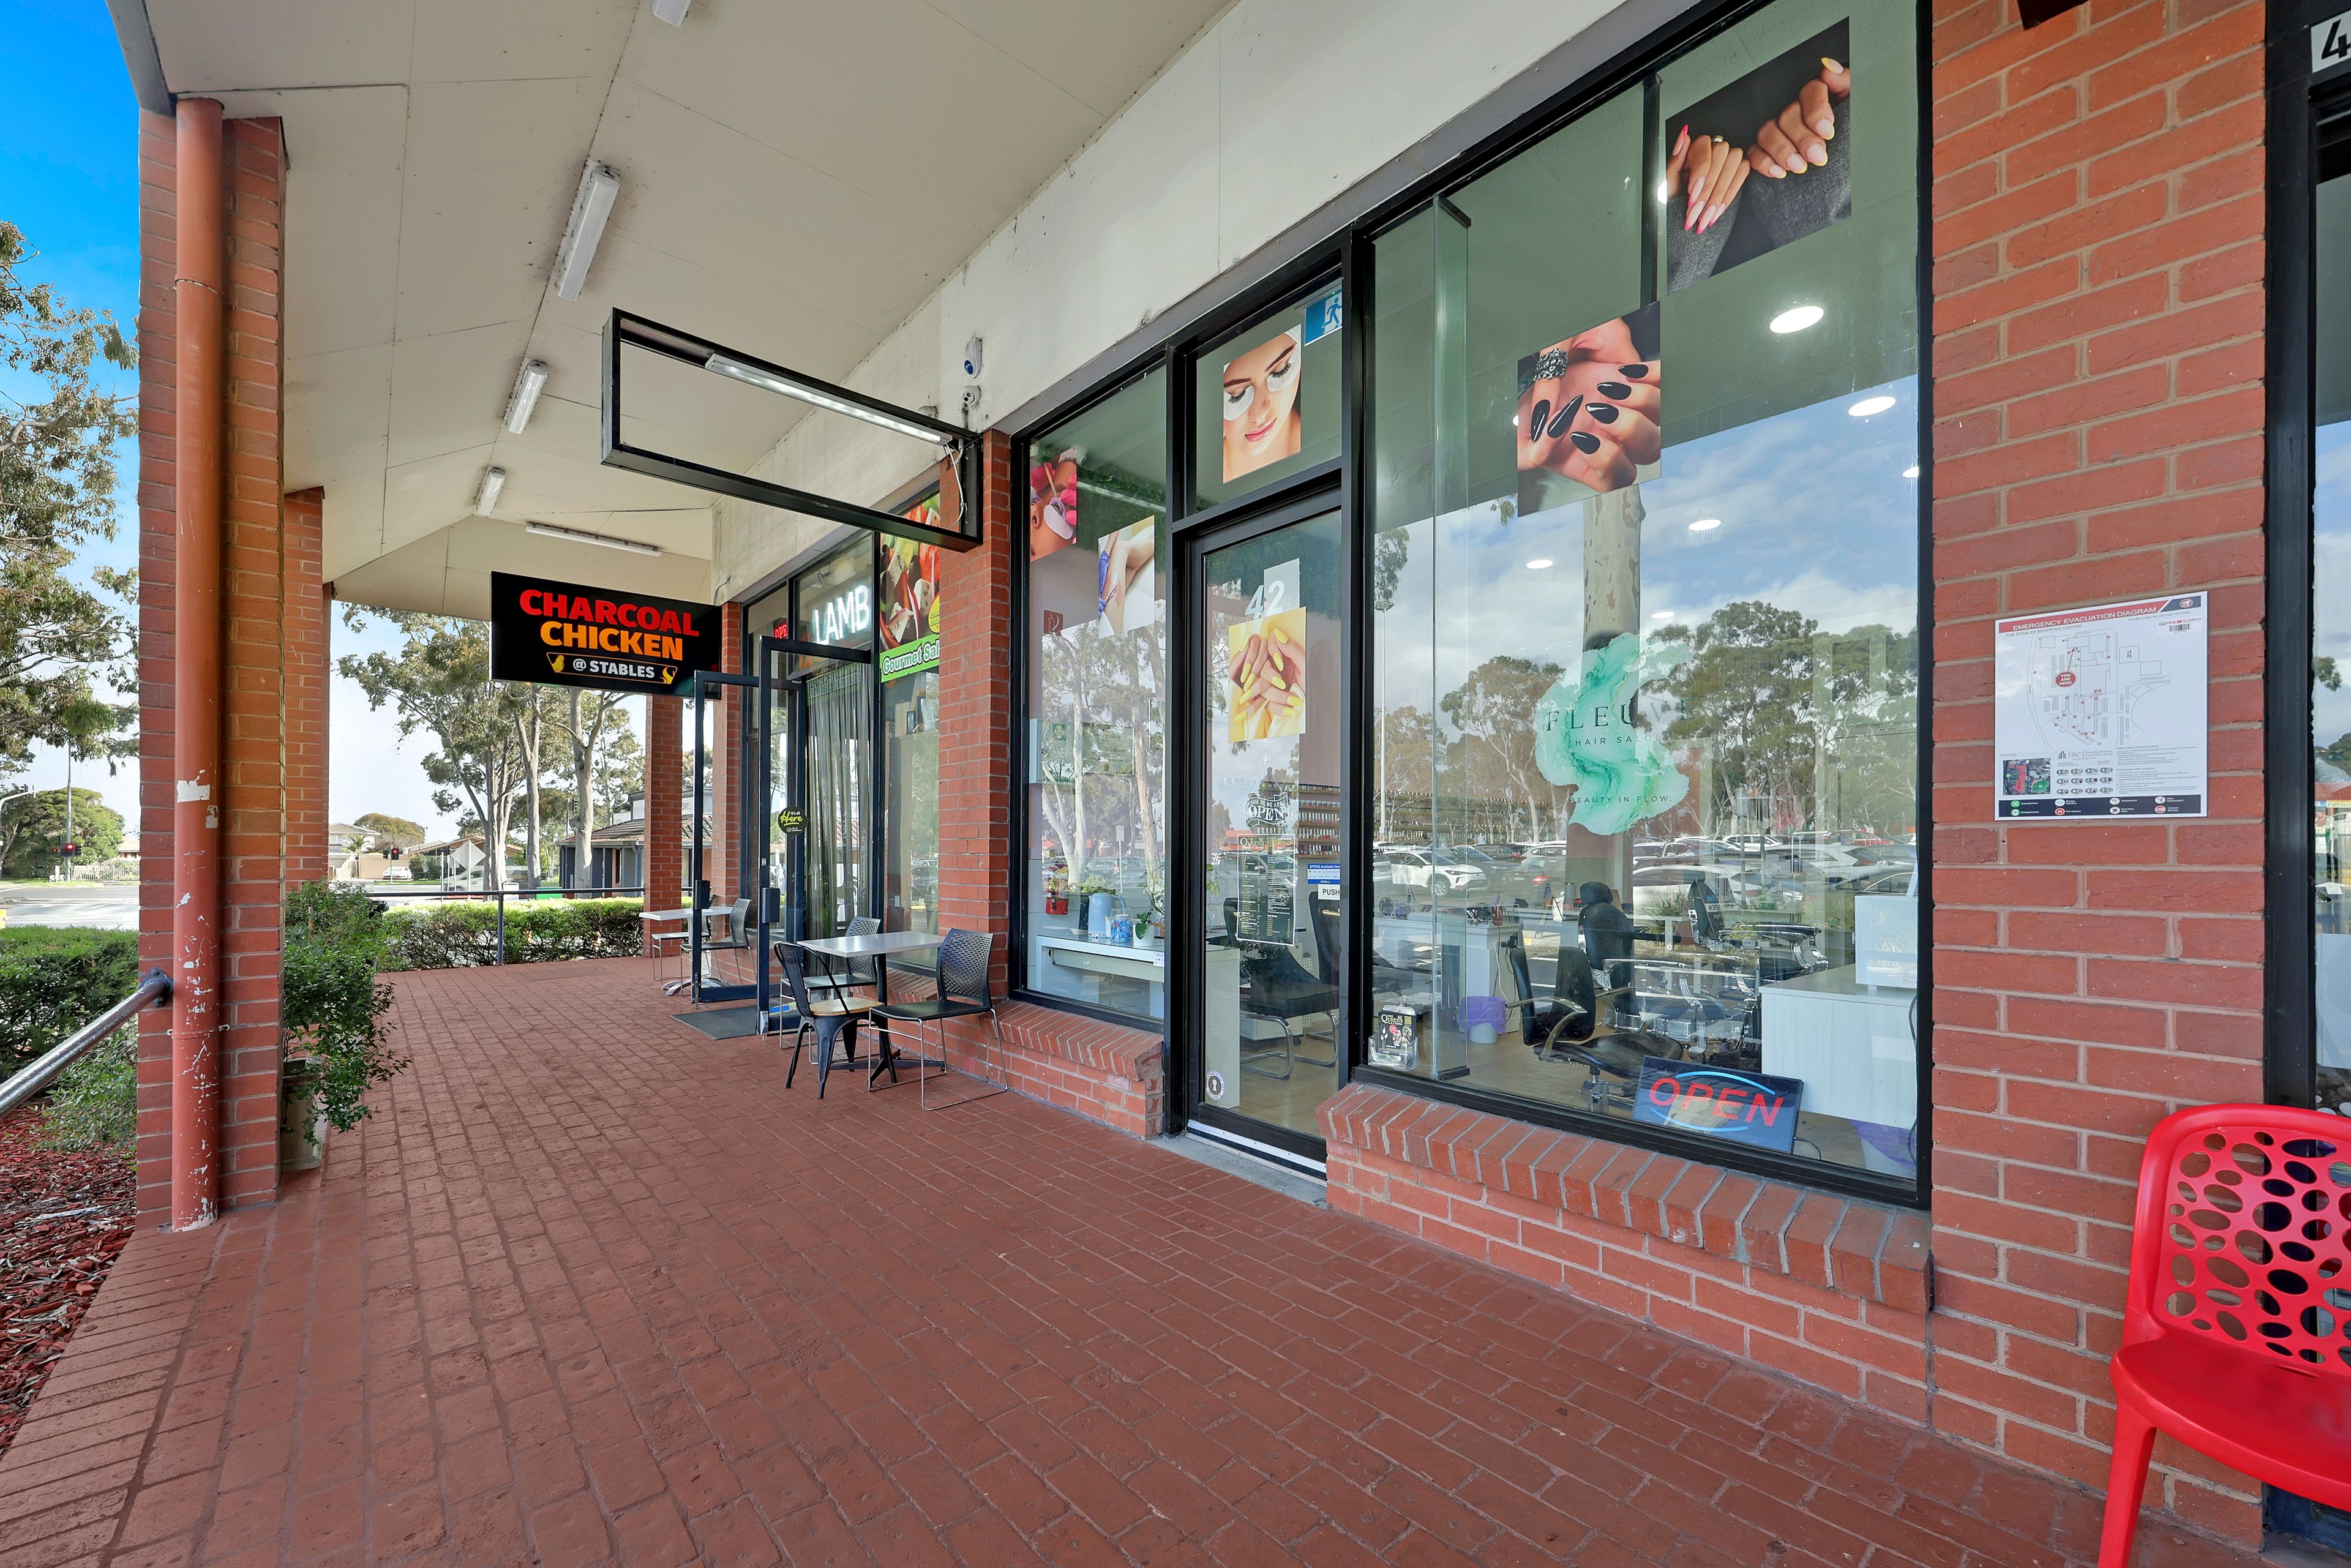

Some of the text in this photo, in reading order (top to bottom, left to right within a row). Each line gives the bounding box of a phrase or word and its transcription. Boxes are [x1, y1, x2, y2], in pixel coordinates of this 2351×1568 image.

[519, 589, 699, 636] CHARCOAL
[1245, 580, 1284, 619] 42
[814, 585, 869, 645] LAMB
[2013, 620, 2061, 631] EMERGENCY
[2064, 611, 2116, 625] EVACUATION
[2117, 607, 2156, 617] DIAGRAM
[540, 621, 683, 661] CHICKEN
[572, 658, 655, 678] @ STABLES
[883, 643, 923, 675] Gourmet
[1547, 697, 1695, 731] FLEUVE
[1575, 735, 1663, 746] HAIR SALON
[780, 811, 803, 823] Here
[1249, 805, 1284, 820] OPEN
[1241, 838, 1265, 847] QUEENS
[1381, 1014, 1403, 1024] QUEENS
[1649, 1077, 1783, 1127] OPEN
